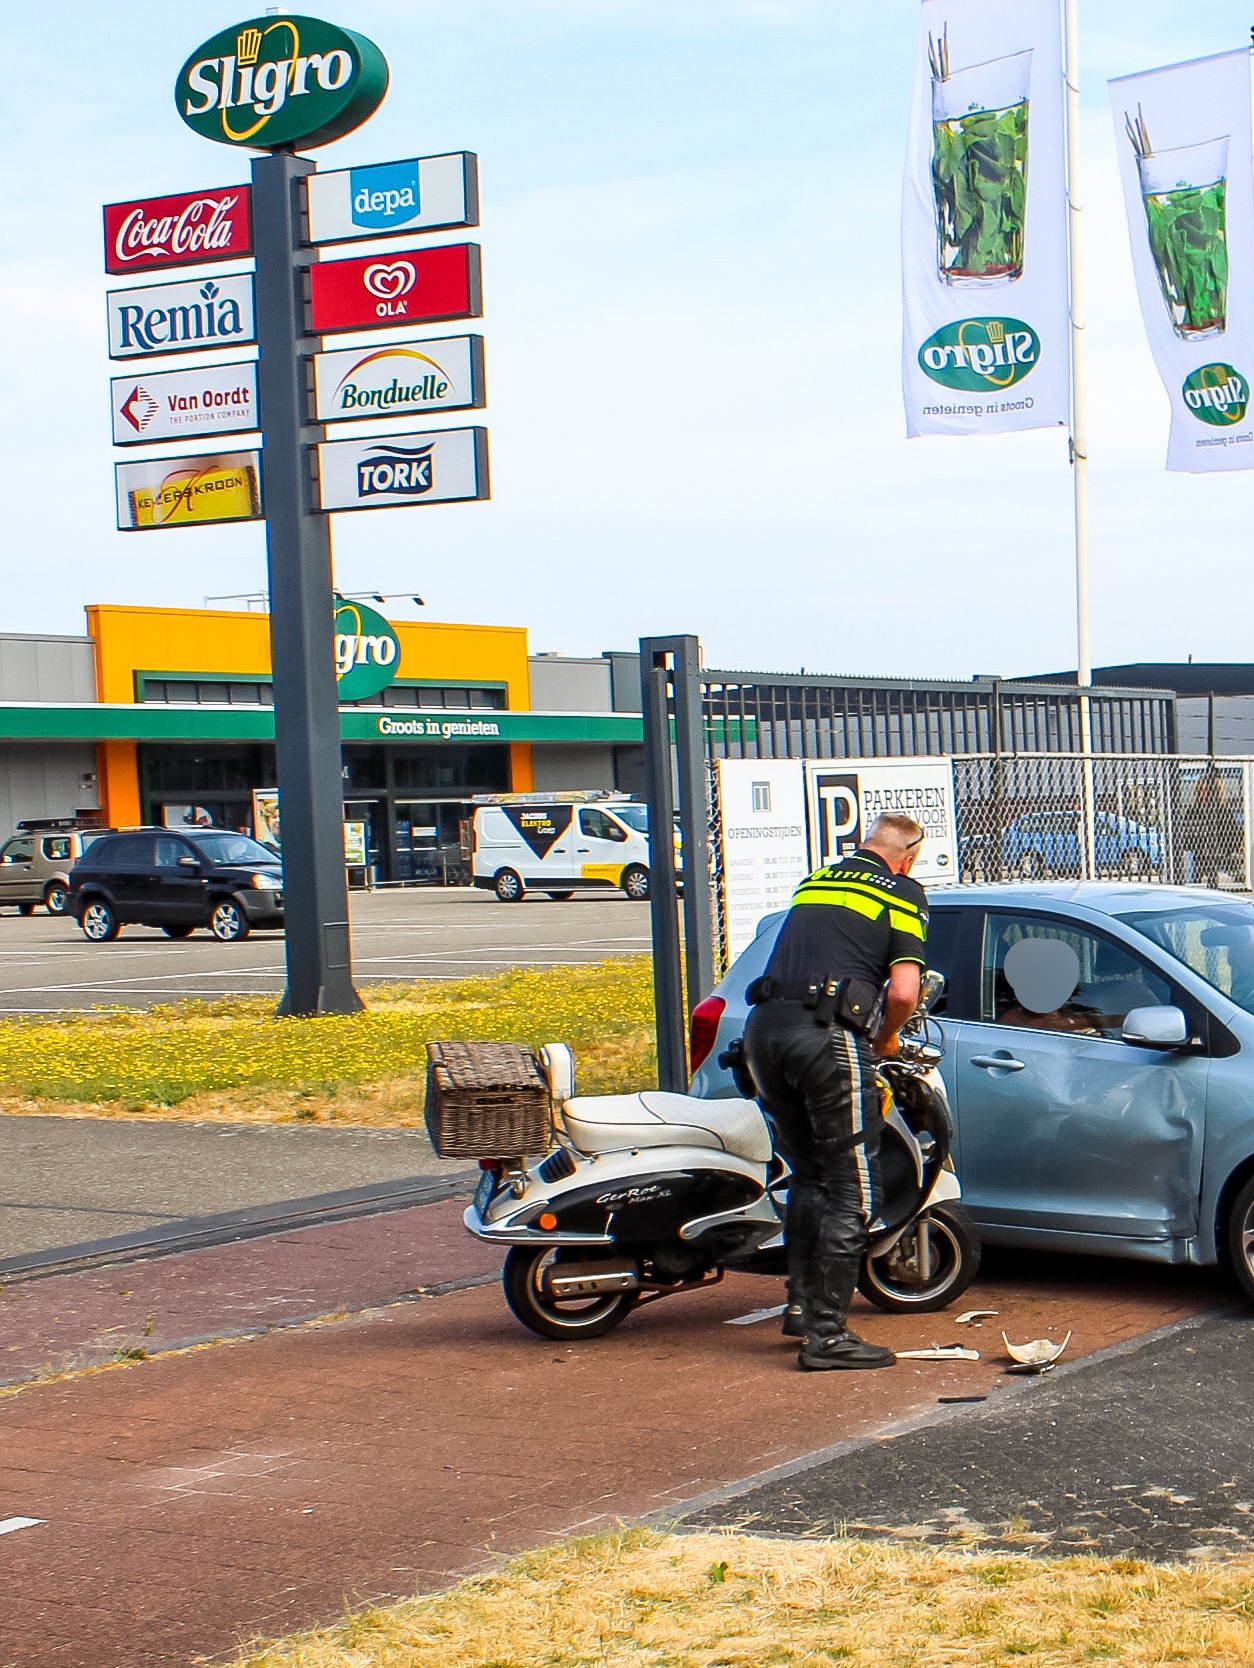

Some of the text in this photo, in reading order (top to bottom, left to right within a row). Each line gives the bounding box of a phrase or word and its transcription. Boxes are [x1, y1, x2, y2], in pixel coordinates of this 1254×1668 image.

[186, 47, 353, 117] Sligro
[354, 187, 416, 216] depa
[114, 194, 240, 261] Coca-Cola
[119, 293, 243, 351] Remia
[376, 301, 405, 317] OLA
[167, 386, 250, 412] Van Oordt
[341, 376, 448, 410] Bonduelle
[185, 412, 215, 423] PORTION
[217, 409, 250, 419] COMPANY
[360, 461, 427, 493] TORK
[334, 633, 396, 675] gro
[378, 716, 500, 740] Groots in genieten
[863, 787, 945, 811] PARKEREN
[521, 820, 551, 828] ELEKTRO
[913, 808, 947, 825] VOOR
[728, 825, 802, 840] OPENINGSTIJDEN
